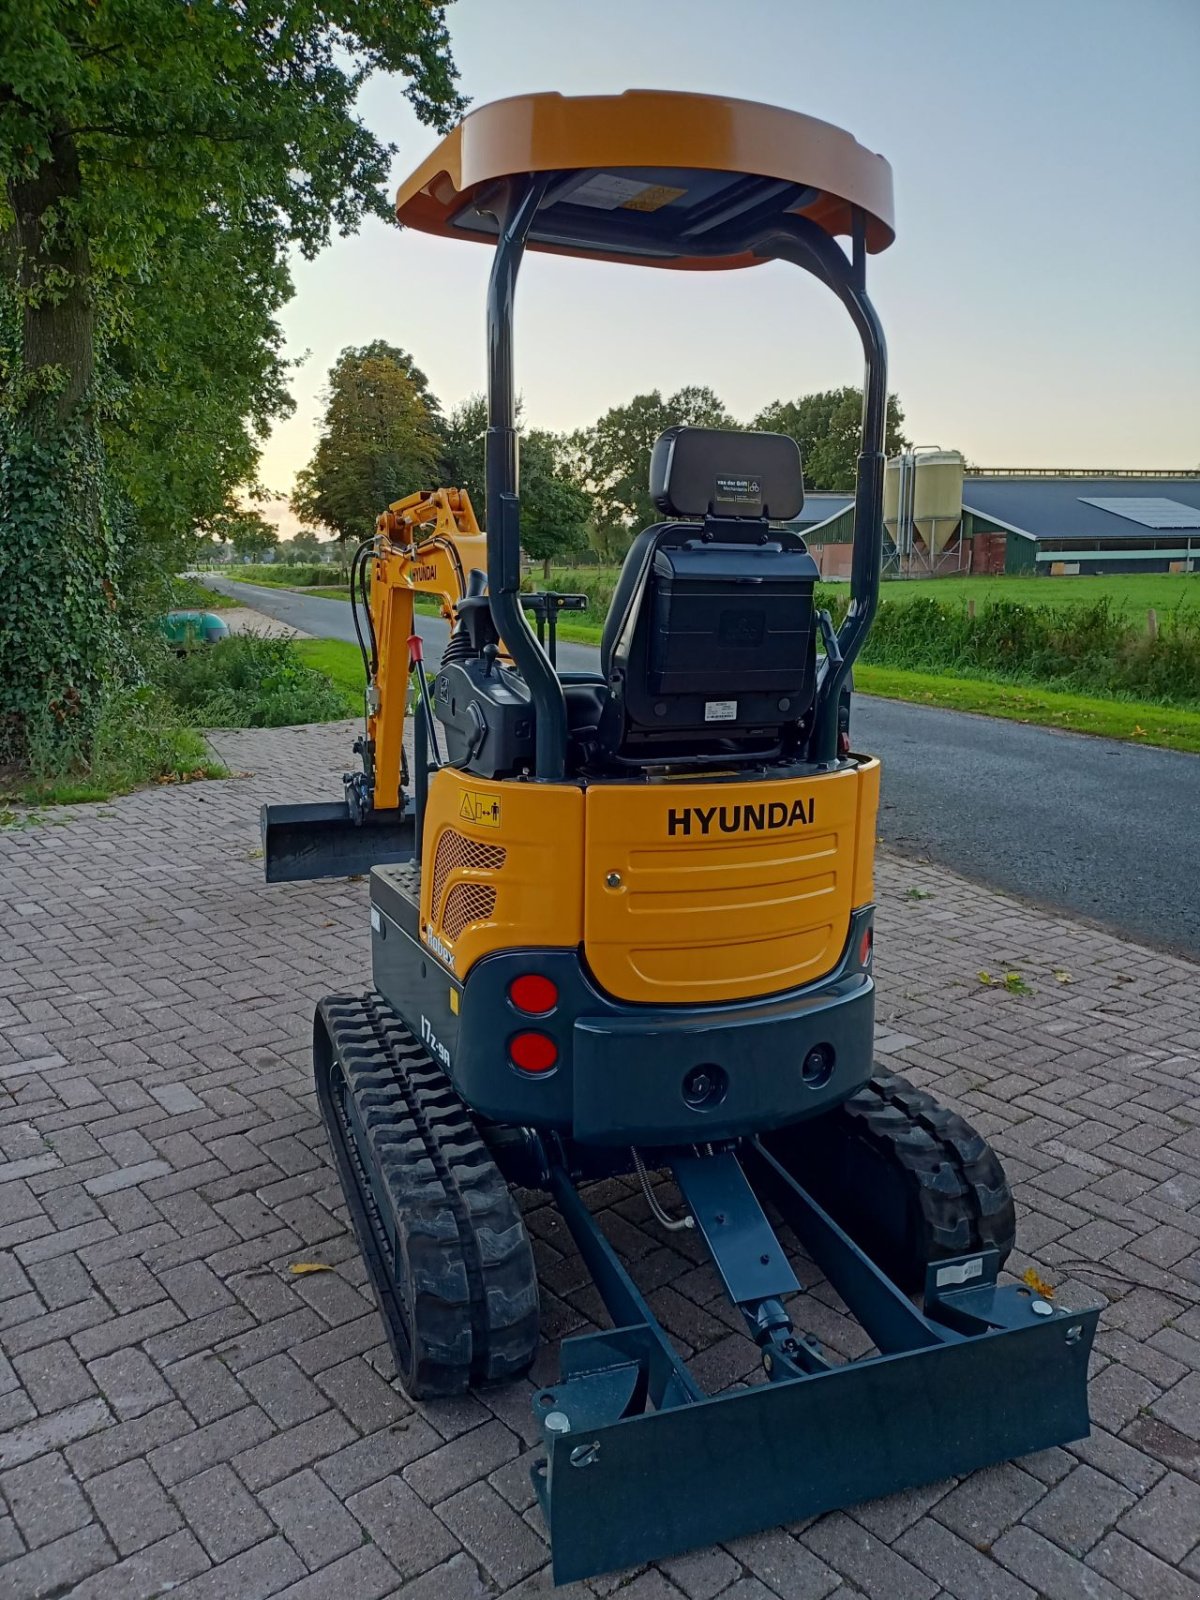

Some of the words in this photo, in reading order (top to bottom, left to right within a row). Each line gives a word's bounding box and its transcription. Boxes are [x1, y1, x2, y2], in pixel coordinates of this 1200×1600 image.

[409, 565, 437, 582] HYUNDAI
[668, 797, 815, 836] HYUNDAI
[427, 925, 455, 970] Robex
